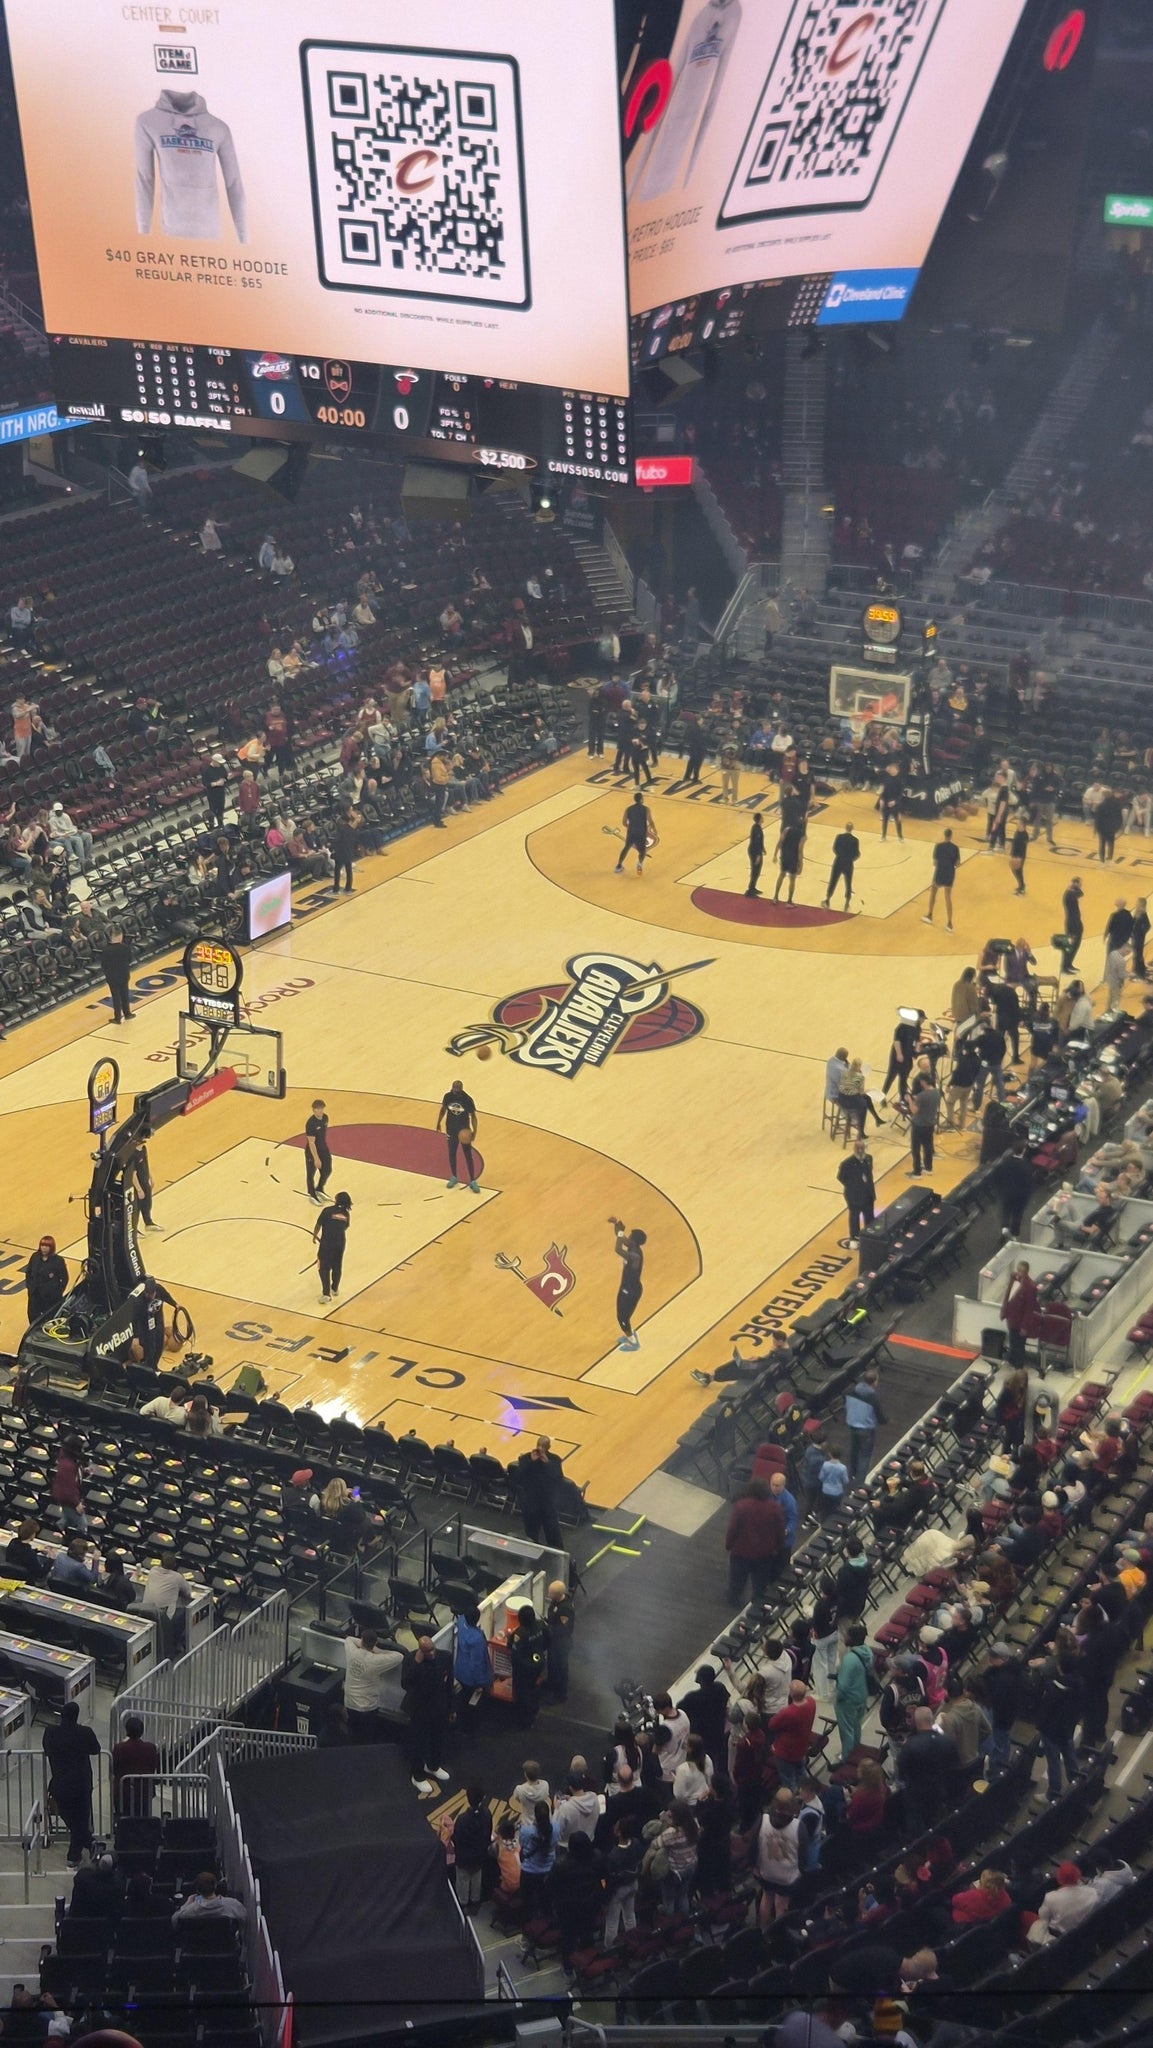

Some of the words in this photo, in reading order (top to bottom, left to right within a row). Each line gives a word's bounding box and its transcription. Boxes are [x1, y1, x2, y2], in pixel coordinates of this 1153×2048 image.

[122, 6, 172, 22] CENTER
[179, 8, 220, 24] COURT
[158, 48, 184, 59] ITEM
[160, 59, 192, 70] GAME
[161, 136, 214, 150] BASKETBALL
[105, 249, 131, 262] $40
[136, 251, 175, 265] GRAY
[180, 255, 228, 270] RETRO
[233, 259, 288, 276] HOODIE
[135, 269, 192, 282] REGULAR
[197, 274, 237, 287] PRICE:
[241, 277, 262, 289] $65
[843, 288, 882, 302] Cleveland
[883, 286, 906, 299] Clinic
[68, 337, 108, 347] CAVALIERS
[217, 356, 224, 366] 0
[300, 365, 320, 380] 1Q
[444, 374, 468, 383] FOULS
[232, 384, 239, 392] 0
[453, 383, 460, 392] 0
[499, 382, 518, 390] HEAT
[233, 395, 240, 404] 0
[270, 392, 285, 415] 0
[68, 403, 105, 416] oswald
[317, 406, 366, 427] 40:00
[174, 415, 232, 431] RAFFLE
[394, 407, 409, 430] 0
[0, 419, 23, 439] ITH
[430, 430, 446, 439] TOL
[455, 433, 467, 442] CH
[480, 450, 526, 470] $2,500
[548, 461, 629, 484] CAVS5050.COM
[636, 464, 667, 480] fubo
[196, 945, 233, 965] 39:59
[203, 998, 234, 1011] TISSOT
[584, 1013, 624, 1064] CLEVELAND
[130, 1250, 141, 1276] Clinic
[729, 1254, 853, 1347] TRUSTEDSEC
[225, 1320, 466, 1389] CLIFFS
